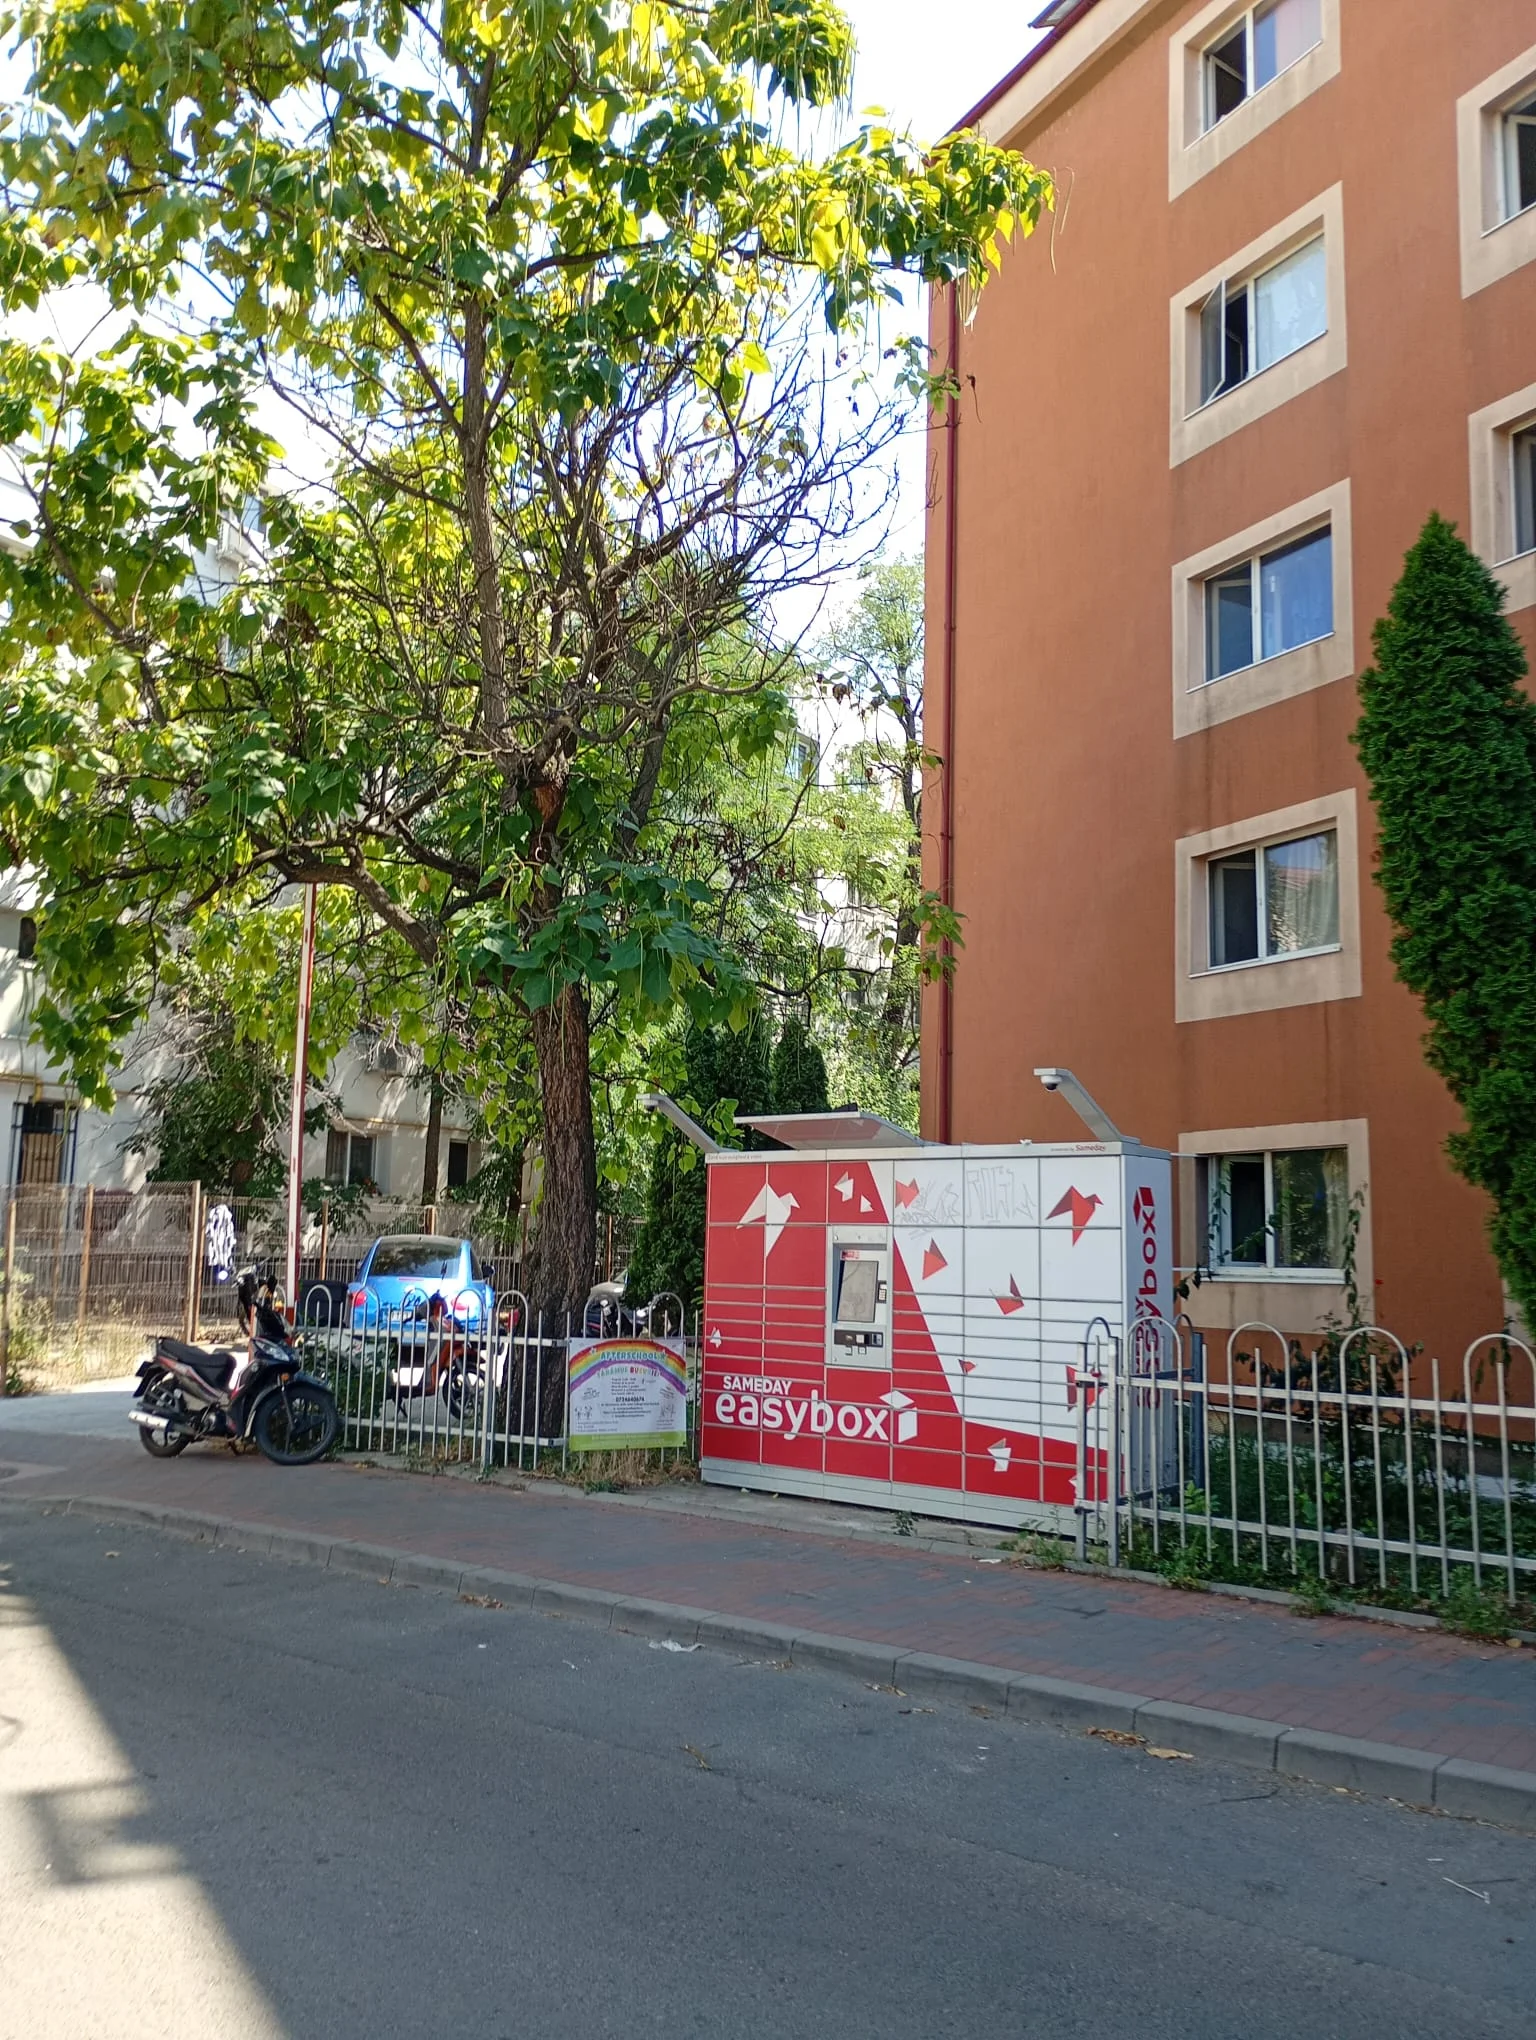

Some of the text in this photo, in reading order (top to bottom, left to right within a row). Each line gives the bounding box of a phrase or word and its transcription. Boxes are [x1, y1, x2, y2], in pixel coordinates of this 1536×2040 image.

[600, 1351, 658, 1361] AFTERSCHOOL
[723, 1375, 793, 1396] SAMEDAY
[715, 1389, 890, 1441] easybox
